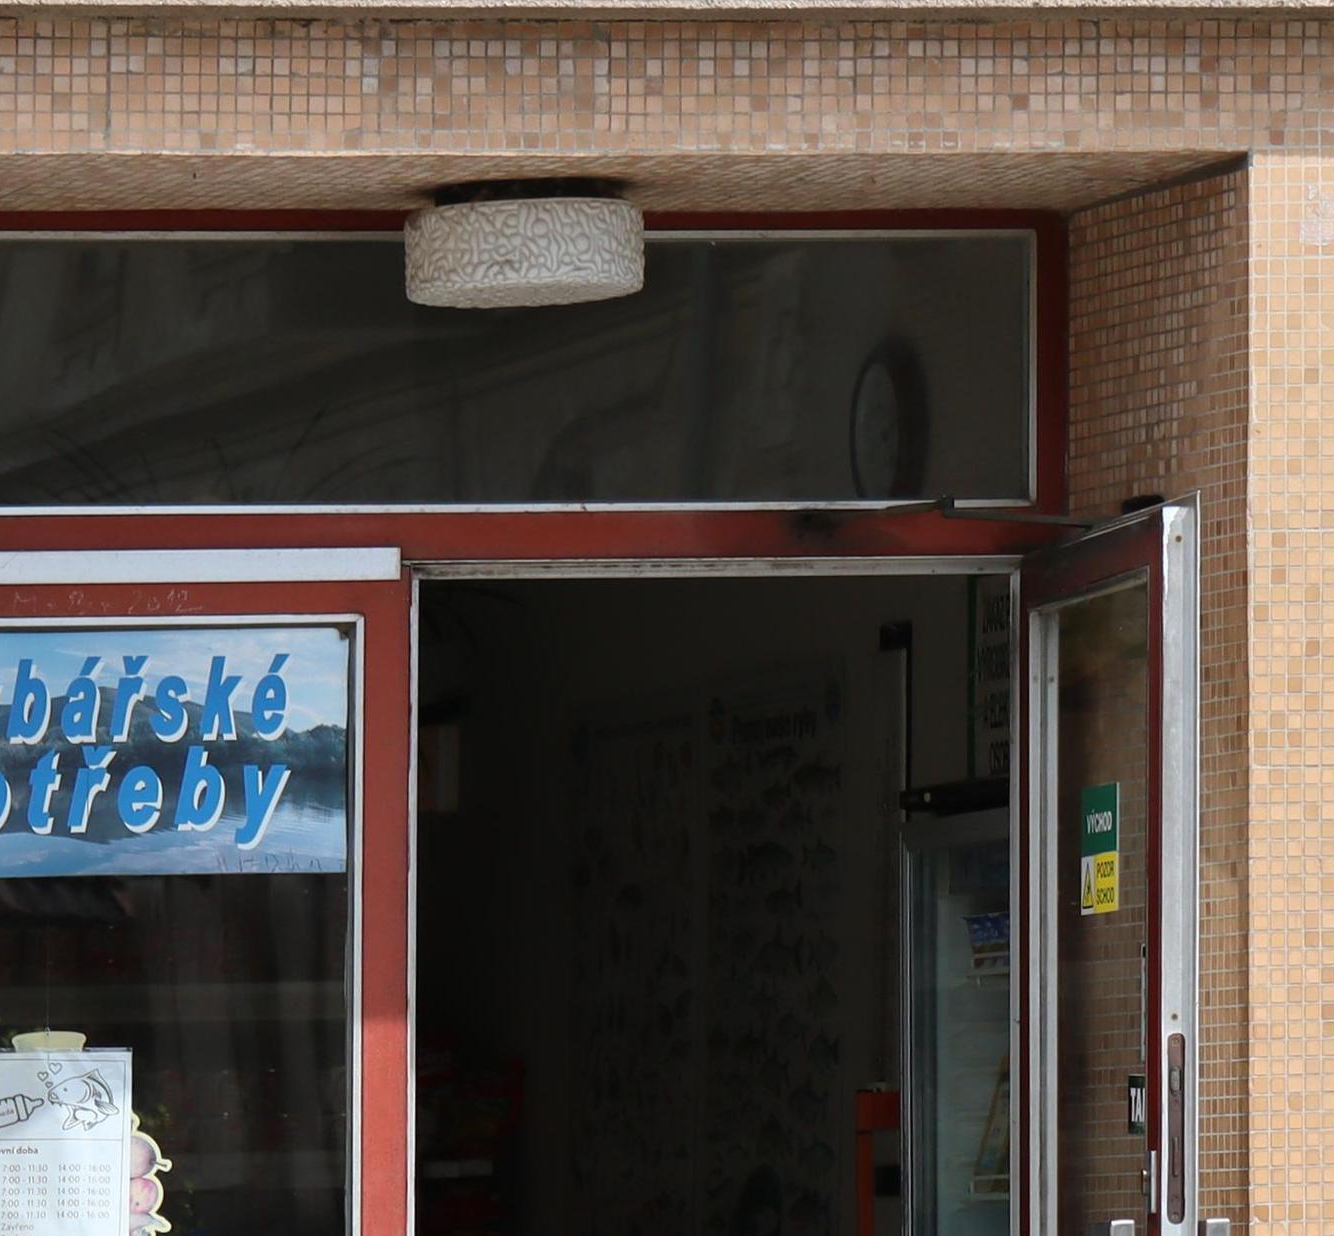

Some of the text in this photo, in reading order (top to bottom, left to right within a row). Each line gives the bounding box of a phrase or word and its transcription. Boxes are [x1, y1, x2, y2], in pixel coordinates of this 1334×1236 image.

[1086, 809, 1113, 834] VÝCHOD
[1096, 860, 1115, 879] POZOR
[1096, 887, 1115, 905] SCHOD
[1130, 1087, 1145, 1122] TA
[16, 1146, 38, 1154] doba
